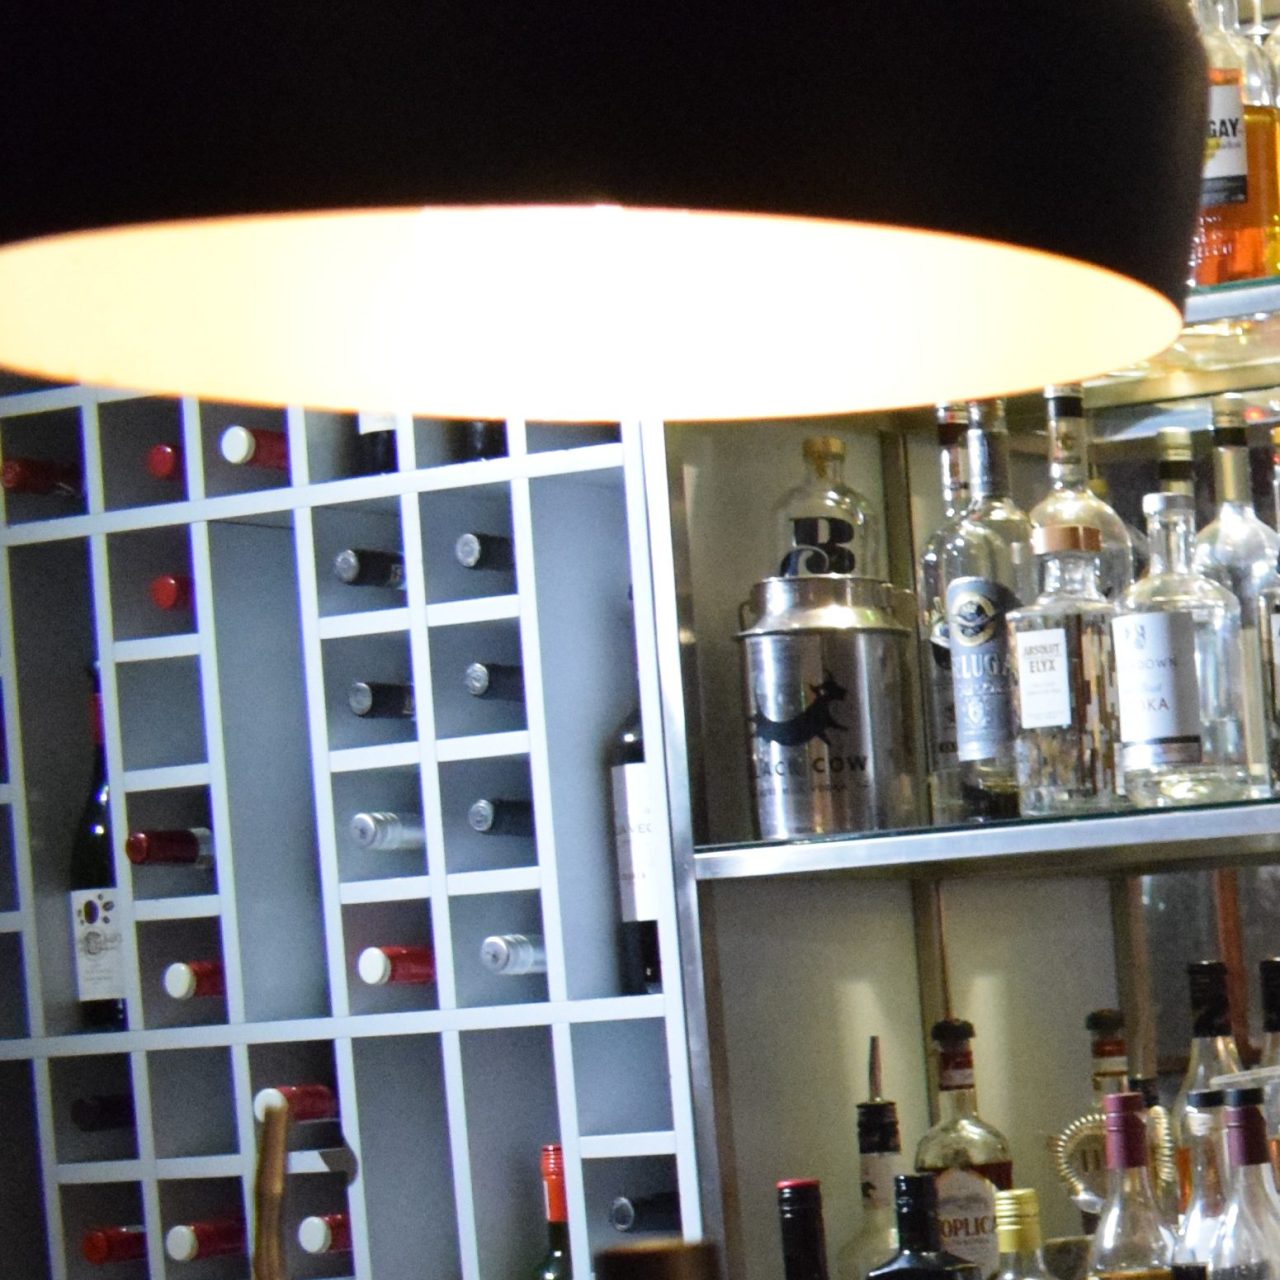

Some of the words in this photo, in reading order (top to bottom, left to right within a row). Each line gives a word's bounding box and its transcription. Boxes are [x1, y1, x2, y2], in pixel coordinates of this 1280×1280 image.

[1024, 643, 1062, 656] ABSOLUT
[1029, 659, 1056, 674] ELYX
[812, 755, 868, 773] COW
